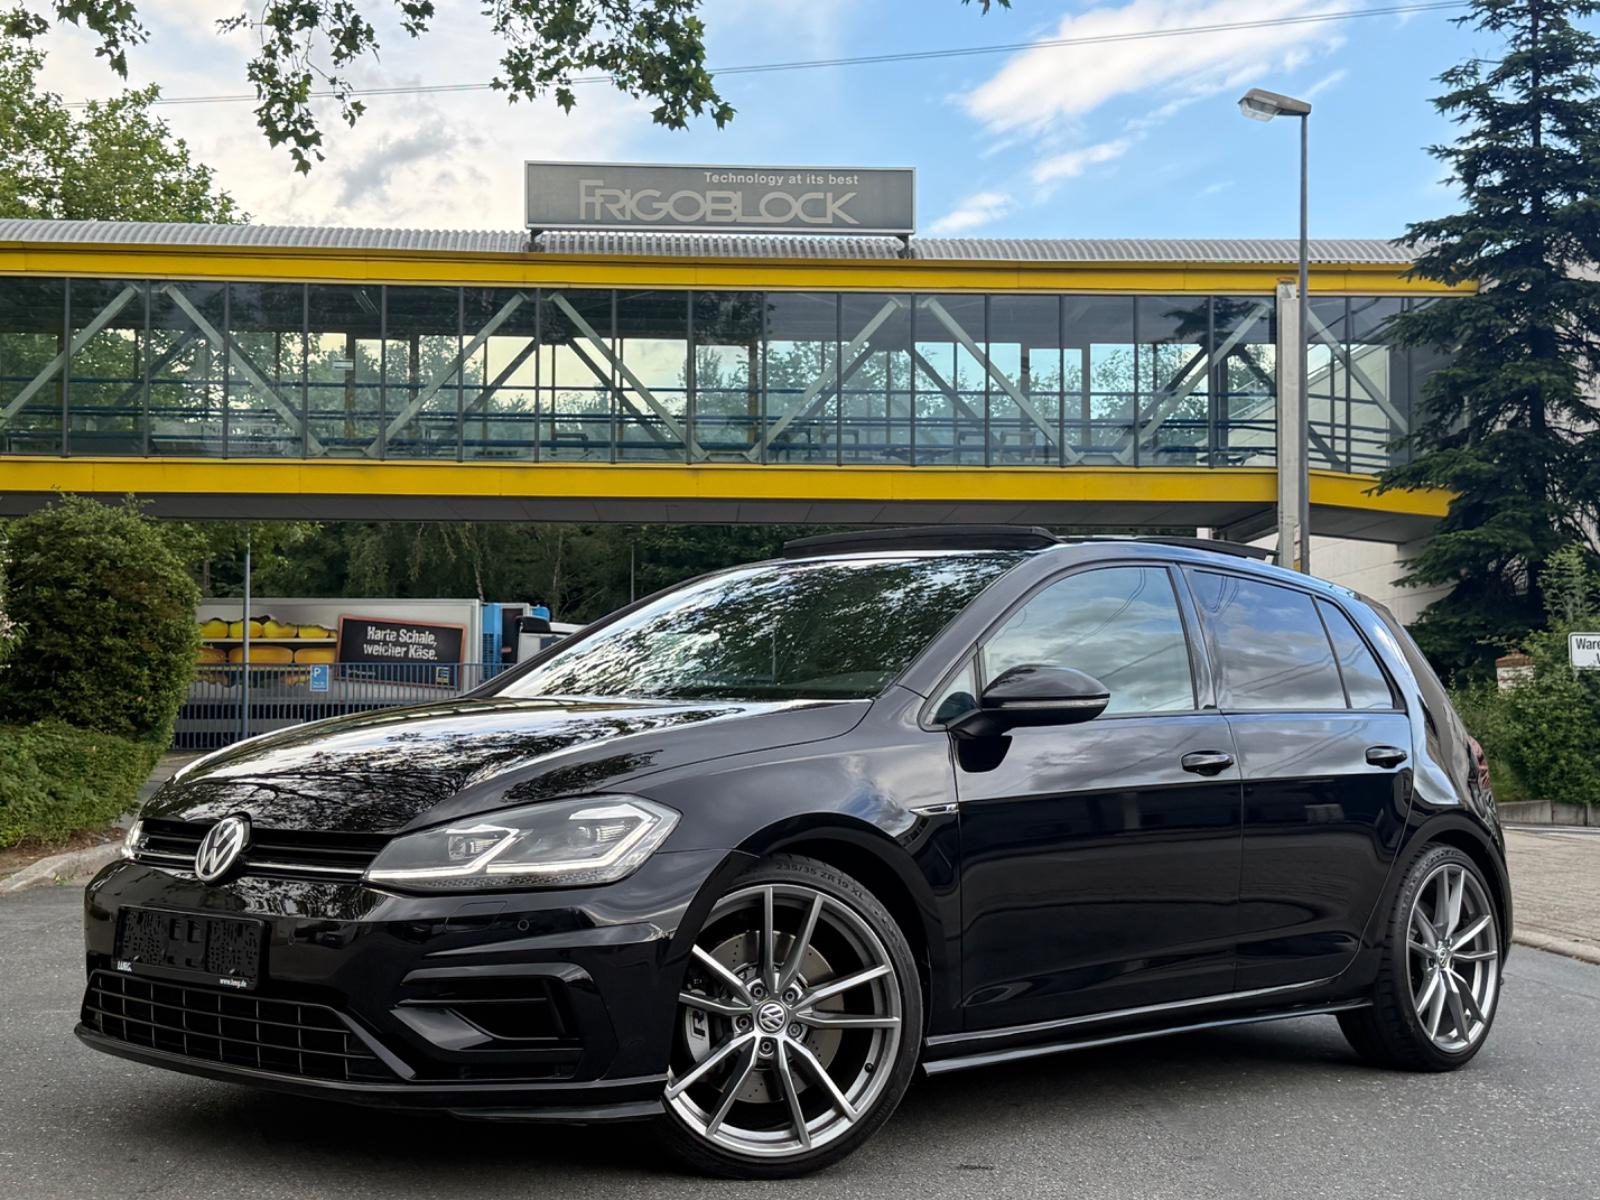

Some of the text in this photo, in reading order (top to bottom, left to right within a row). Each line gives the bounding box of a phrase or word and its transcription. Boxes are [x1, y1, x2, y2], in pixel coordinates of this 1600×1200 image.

[704, 172, 859, 186] Technology at its best
[580, 180, 861, 225] FRIGOBLOCK
[367, 626, 438, 647] Harte Schale,
[363, 642, 438, 661] weicher Käse.
[313, 667, 321, 678] P
